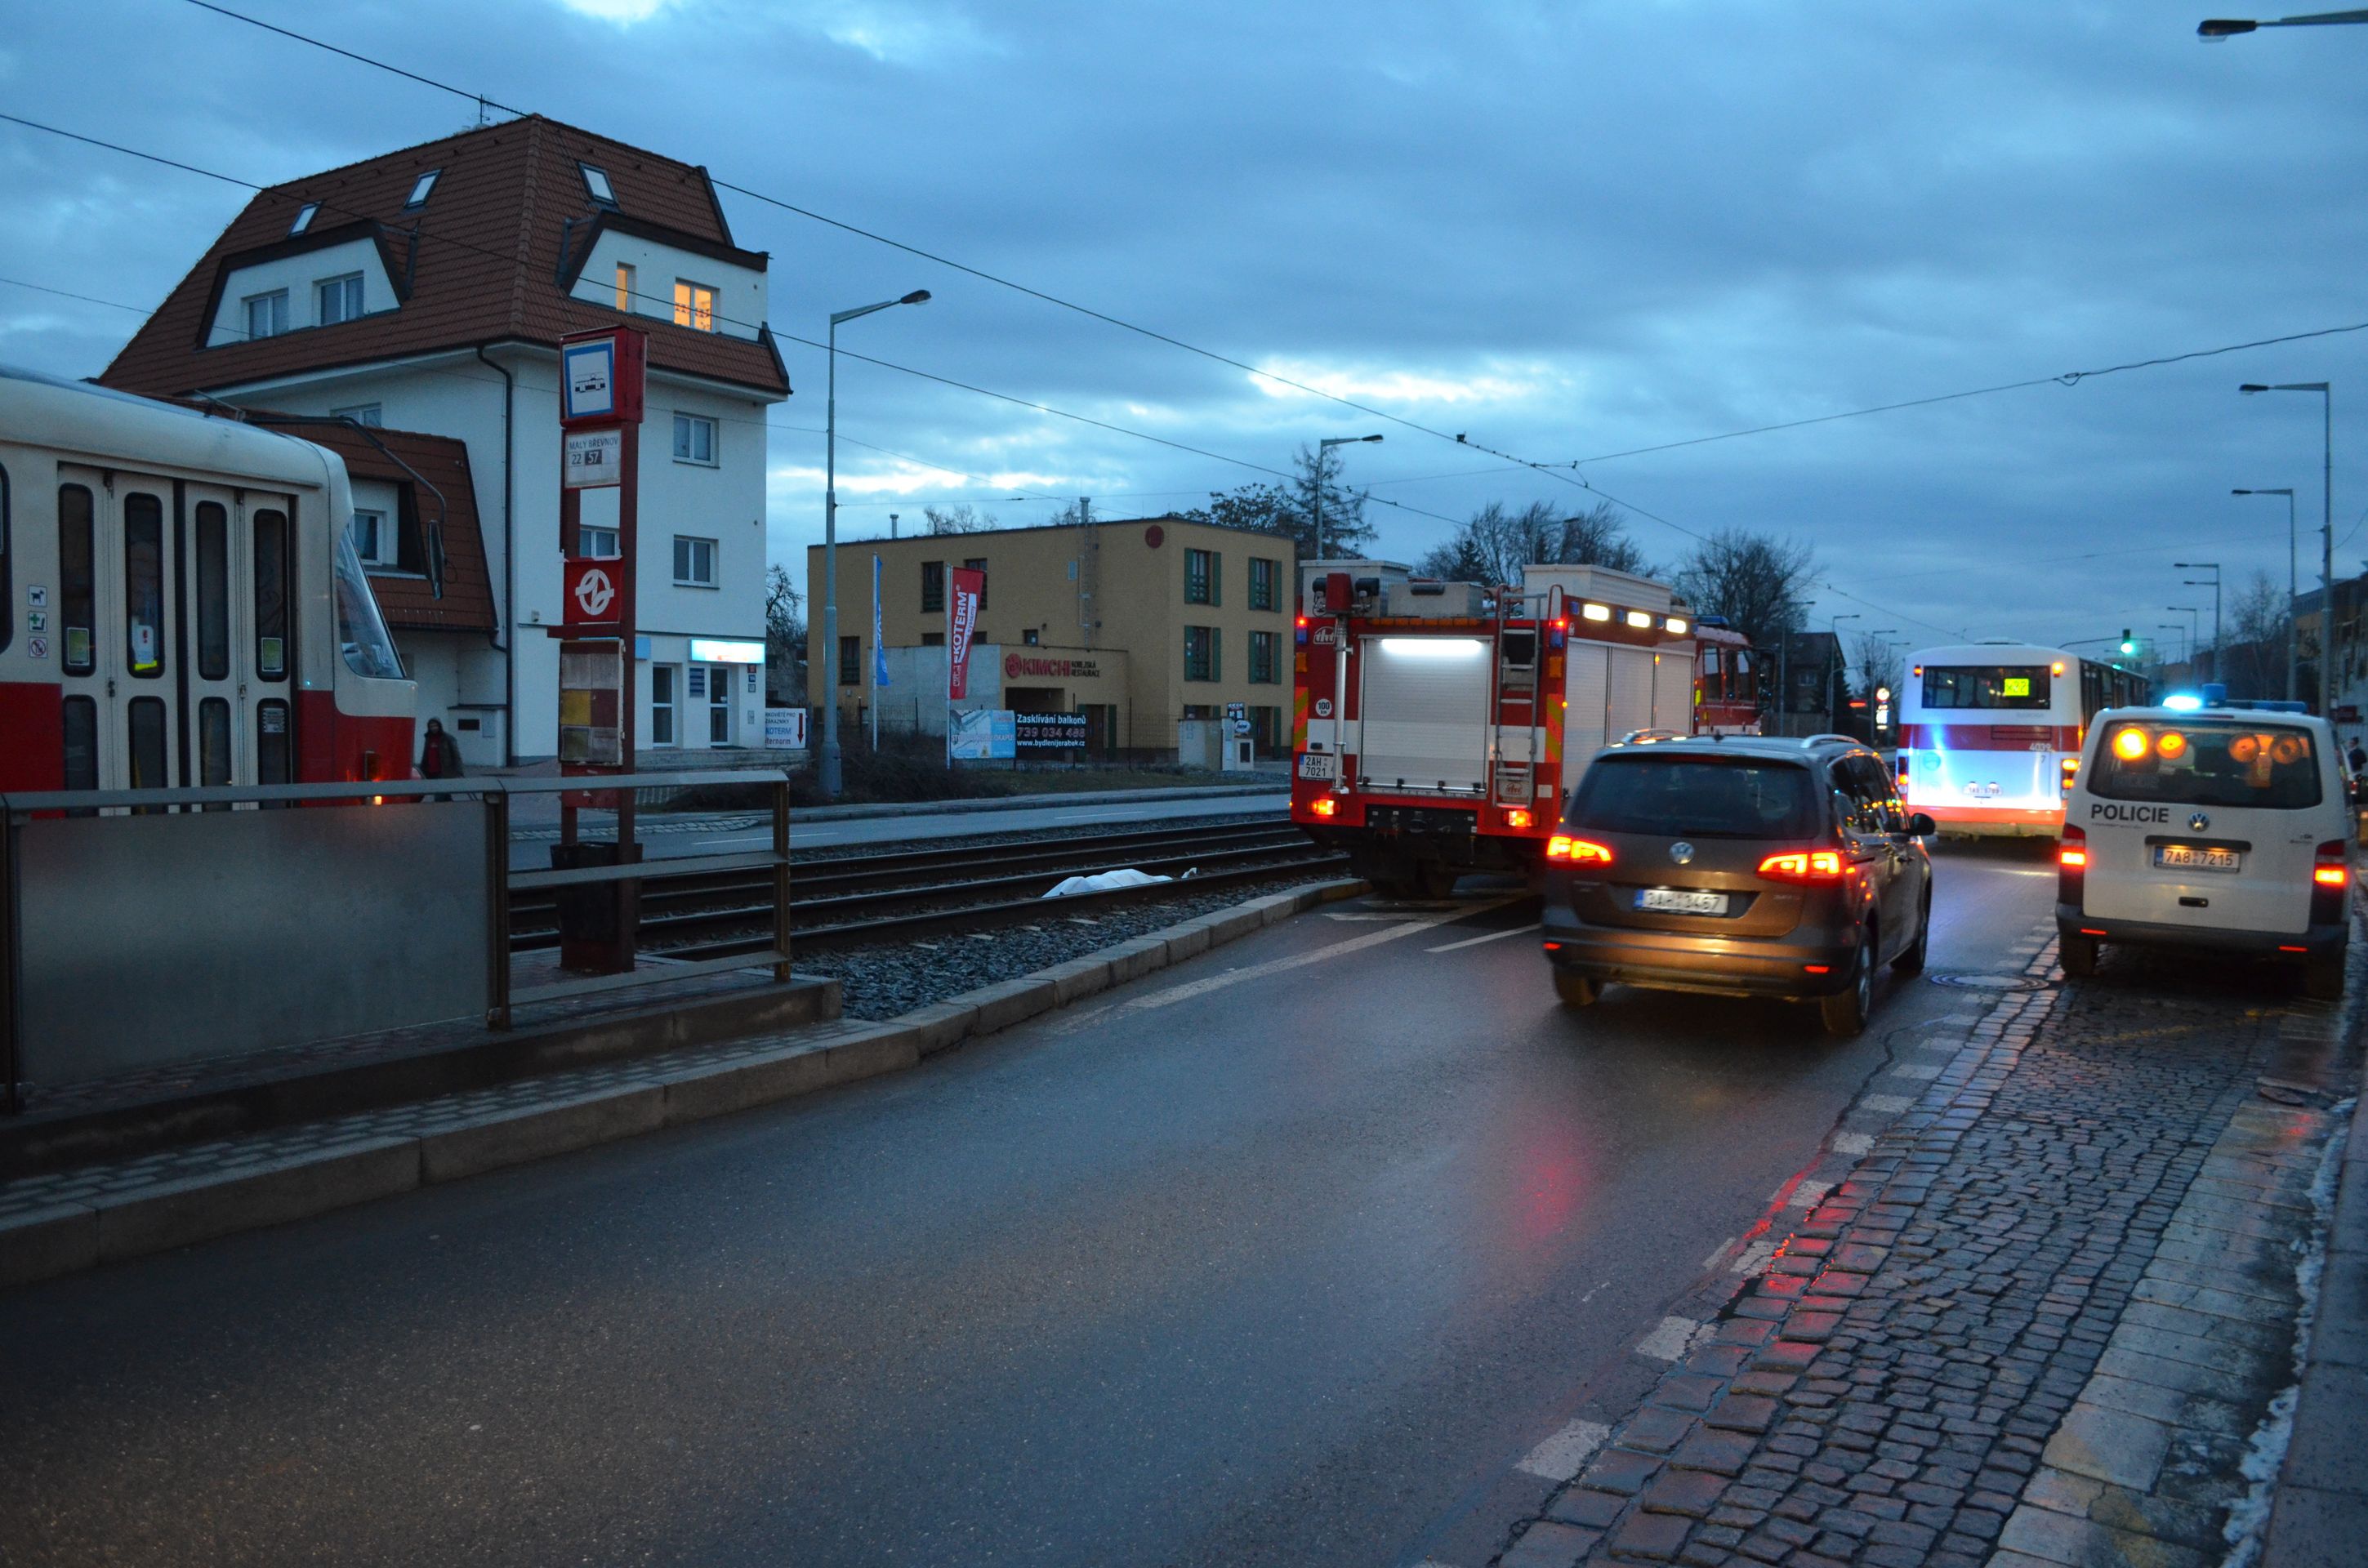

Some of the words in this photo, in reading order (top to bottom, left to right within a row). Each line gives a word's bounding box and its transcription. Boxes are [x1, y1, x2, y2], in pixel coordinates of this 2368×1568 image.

[572, 453, 582, 465] 22
[588, 451, 600, 464] 57
[1023, 658, 1071, 677] KIMCHI
[1318, 702, 1330, 710] 100
[1017, 727, 1038, 737] 739
[1041, 727, 1063, 737] 034
[1306, 756, 1322, 766] 2AH
[1306, 767, 1326, 777] 7021
[2091, 804, 2170, 823] POLICIE
[2166, 850, 2191, 864] 7A8
[2200, 853, 2233, 866] 7215
